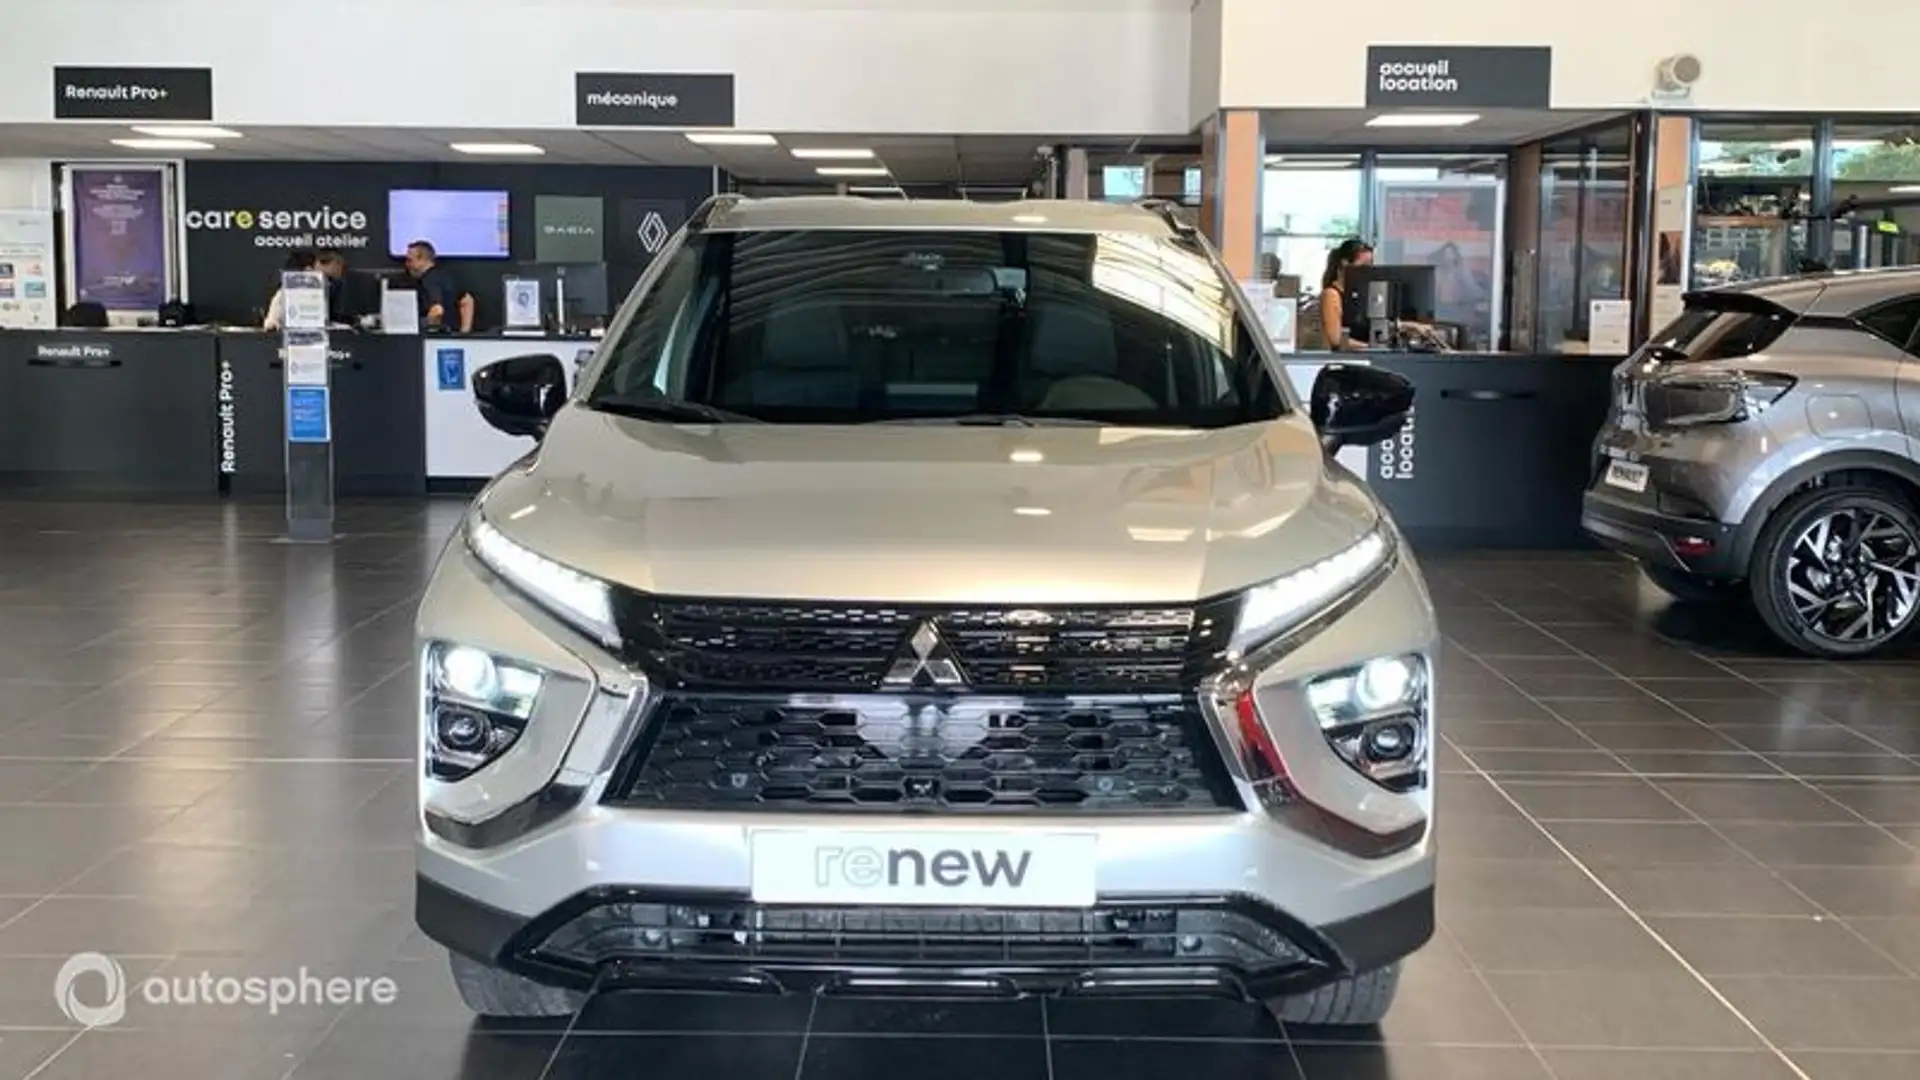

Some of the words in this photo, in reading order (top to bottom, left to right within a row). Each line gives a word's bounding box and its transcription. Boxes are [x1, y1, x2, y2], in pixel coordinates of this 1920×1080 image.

[1379, 59, 1449, 76] accueil
[1379, 73, 1459, 92] location
[65, 84, 129, 100] Renault
[130, 84, 169, 101] Pro+
[587, 90, 679, 109] mécanique
[186, 210, 254, 230] care
[258, 205, 367, 230] service
[254, 233, 314, 248] accueil
[315, 233, 369, 248] atelier
[37, 344, 81, 358] Renault
[219, 359, 234, 401] Pro+
[219, 402, 236, 473] Renault
[814, 845, 1033, 889] renew
